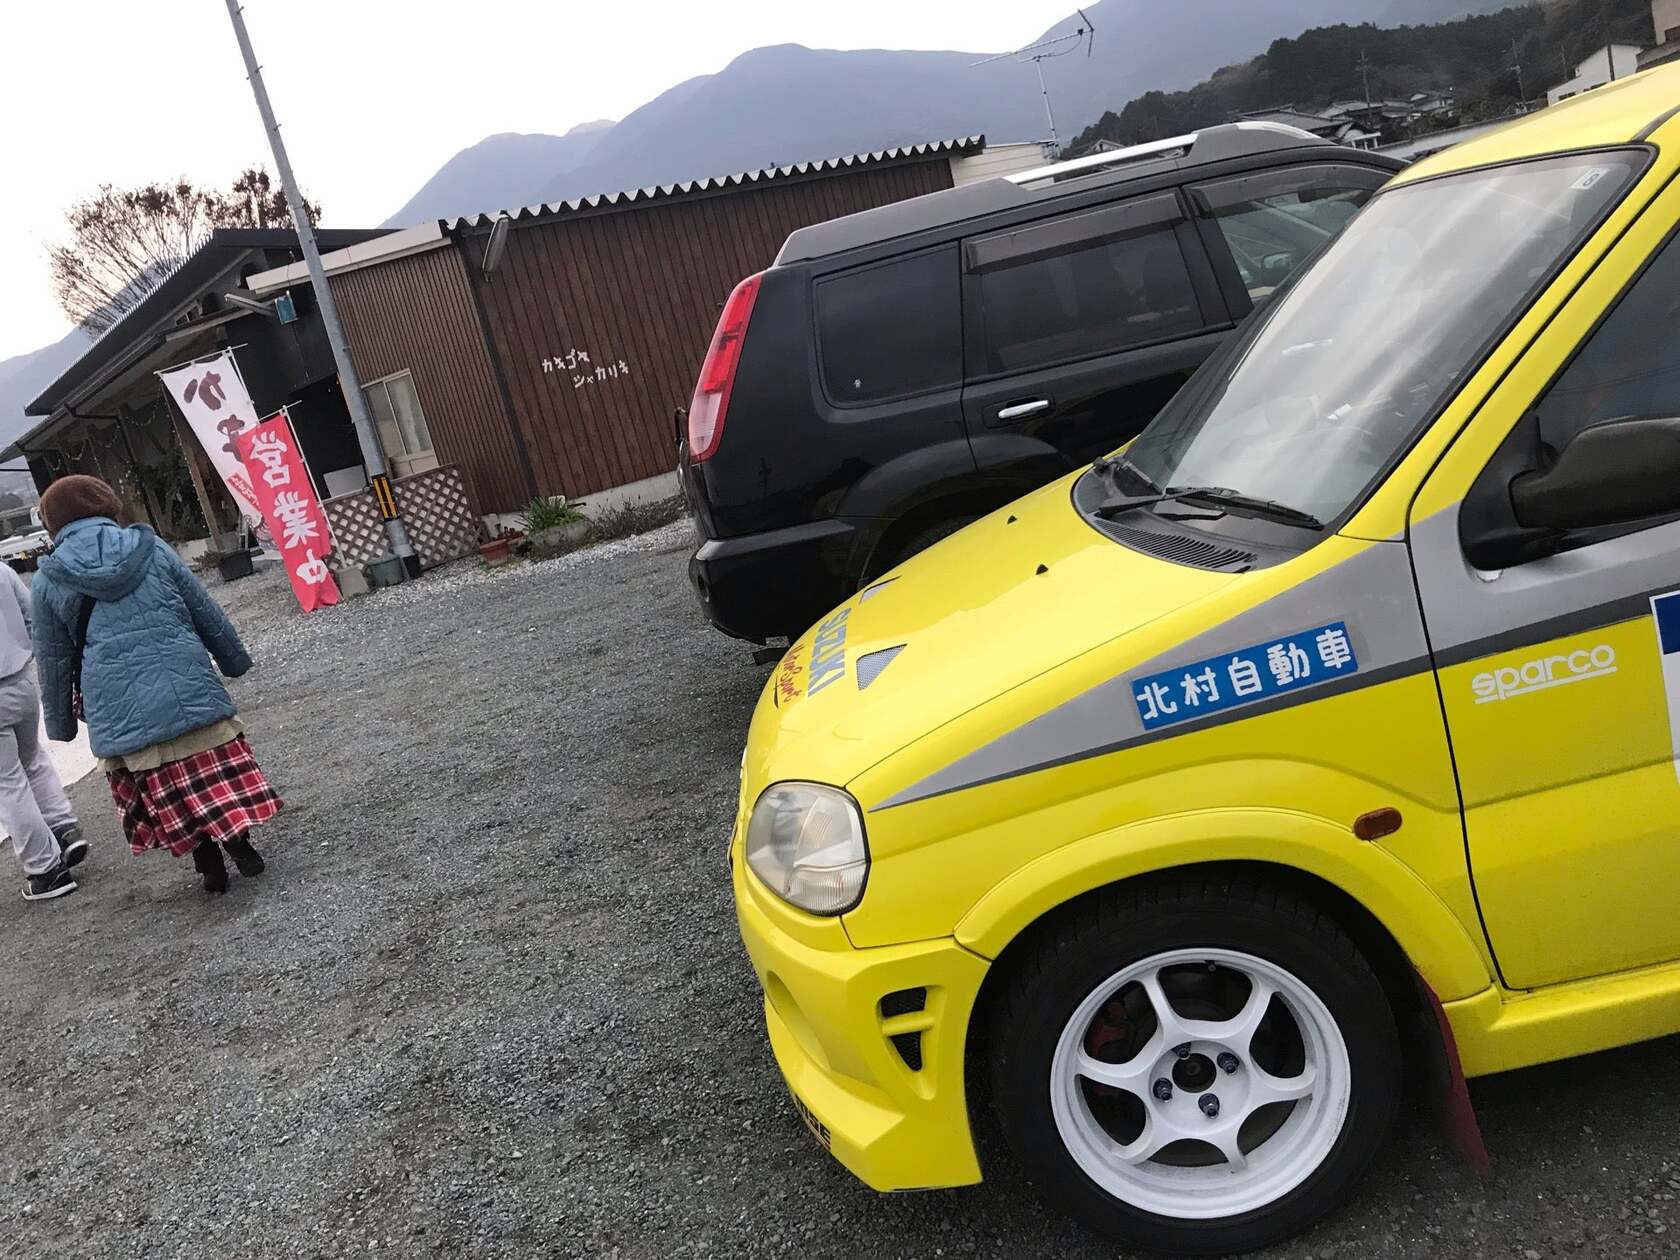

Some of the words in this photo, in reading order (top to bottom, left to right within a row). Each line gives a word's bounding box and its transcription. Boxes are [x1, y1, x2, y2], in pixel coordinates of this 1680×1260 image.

[573, 360, 629, 388] シャカリキ
[250, 431, 329, 584] 営業中
[808, 607, 852, 697] SUZUKI
[1136, 629, 1352, 720] 北村自動車
[1471, 644, 1618, 704] sparco
